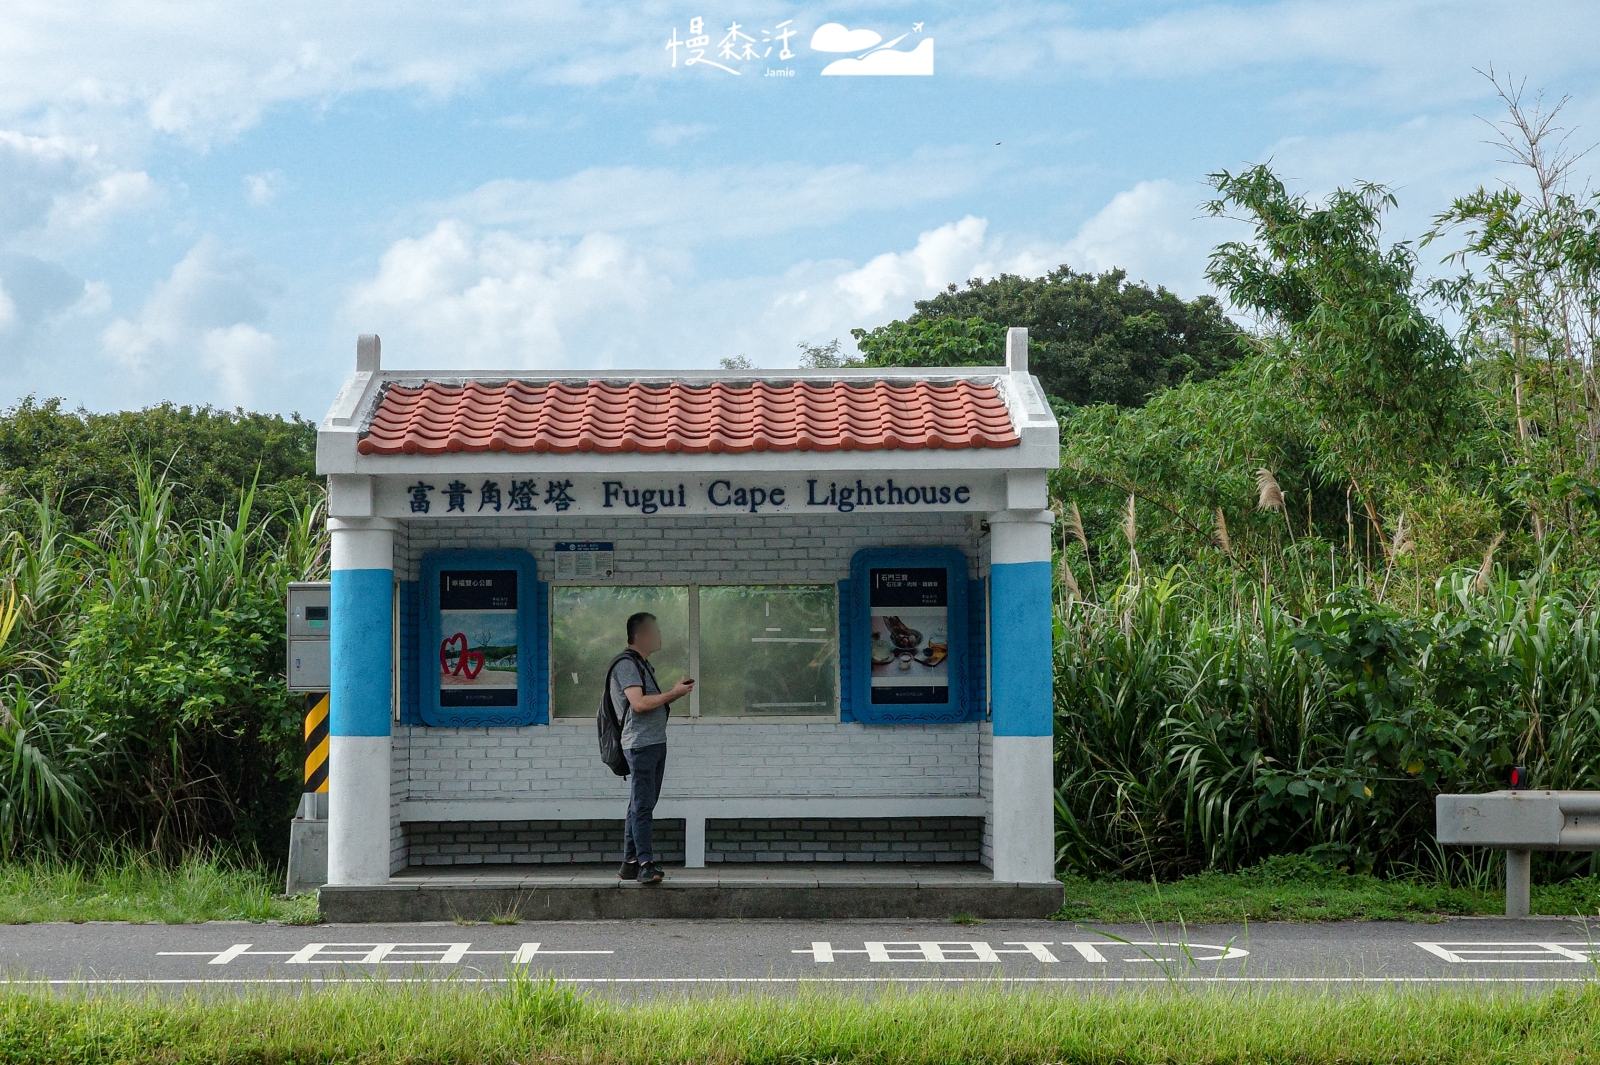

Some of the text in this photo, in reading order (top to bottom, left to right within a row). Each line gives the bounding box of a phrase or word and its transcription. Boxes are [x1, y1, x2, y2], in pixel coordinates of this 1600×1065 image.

[407, 480, 576, 514] 富貴角燈塔
[602, 478, 971, 515] Fugui Cape Lighthouse
